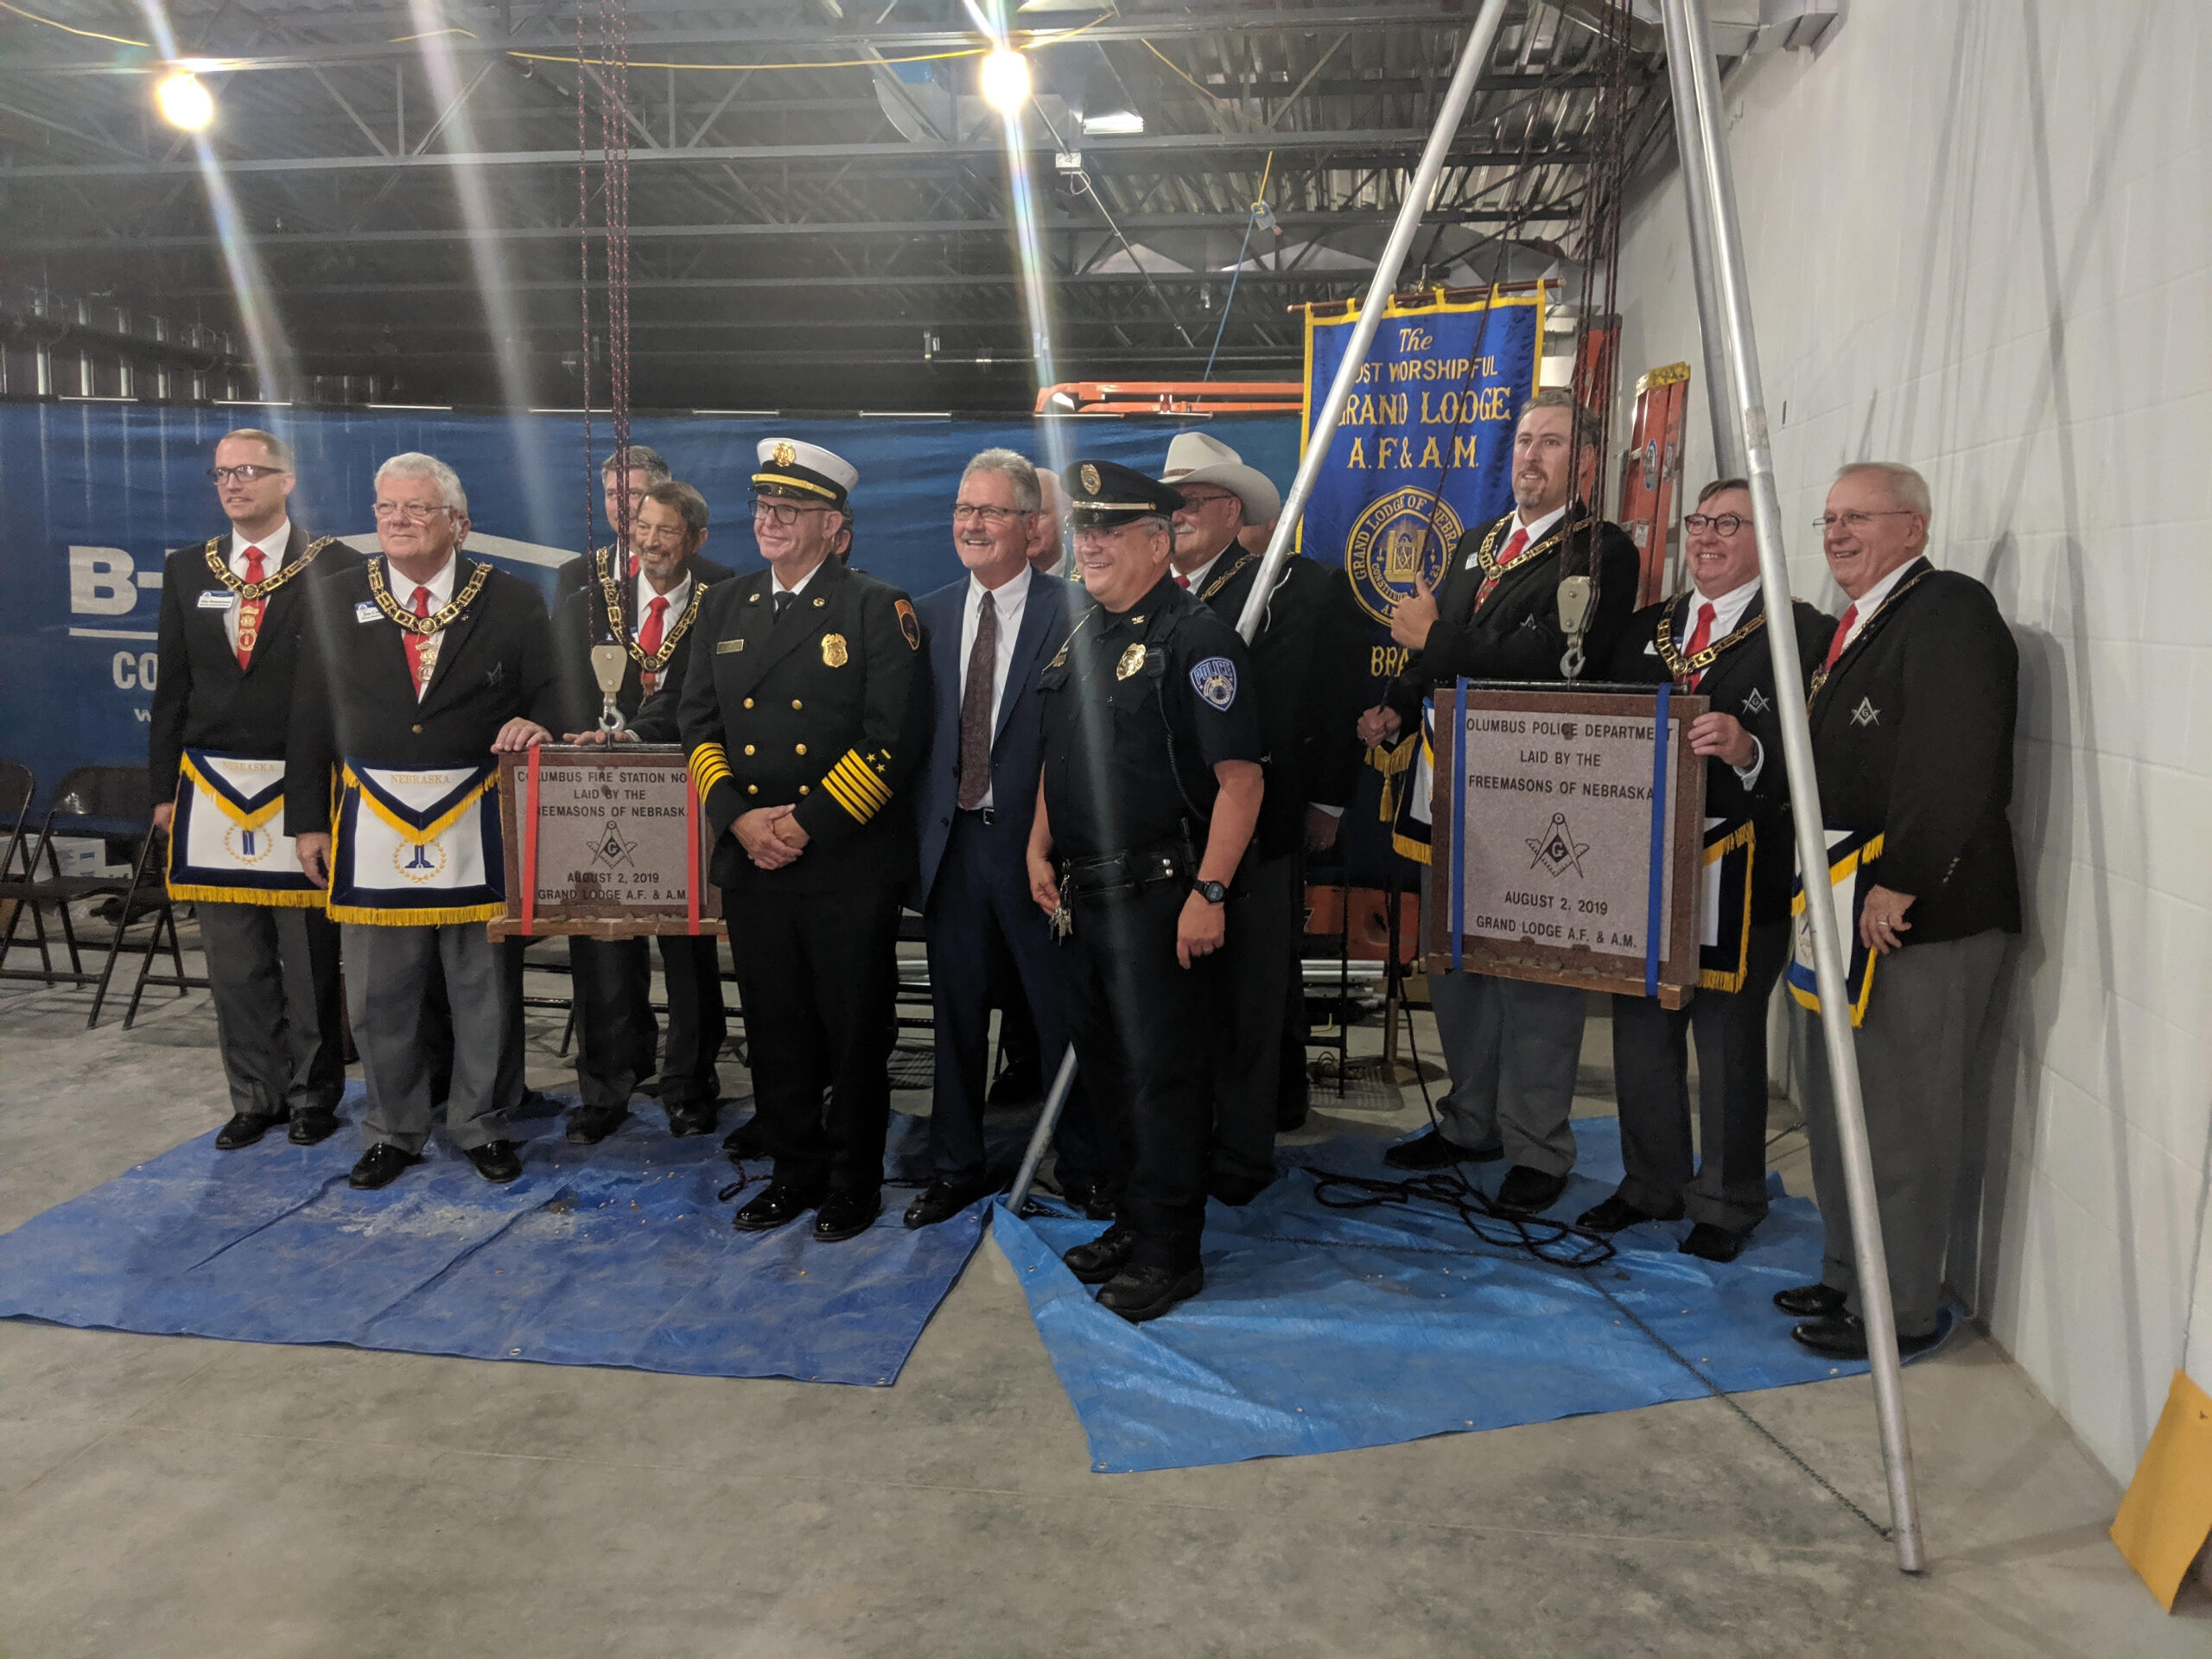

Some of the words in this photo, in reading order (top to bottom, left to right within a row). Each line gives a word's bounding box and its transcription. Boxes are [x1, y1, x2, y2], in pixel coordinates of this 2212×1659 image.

[1399, 327, 1433, 353] The
[1355, 362, 1383, 384] ST
[1389, 355, 1497, 382] WORSHIPFUL
[1420, 387, 1512, 424] LODGE
[1352, 531, 1371, 581] GRAND
[1366, 495, 1406, 531] LODGE
[1407, 494, 1427, 511] OF
[1427, 506, 1458, 559] NEBRA
[1371, 563, 1408, 601] CONSTITU
[1193, 660, 1234, 685] POLICE
[1466, 718, 1526, 734] OLUMBUS
[1532, 721, 1578, 737] POLICE
[1585, 723, 1674, 742] DEPARTMET
[1520, 749, 1548, 764] LAID
[1555, 752, 1571, 765] BY
[1576, 753, 1601, 767] THE
[390, 773, 450, 785] NEBRASKA
[518, 771, 582, 783] CUMBUS
[588, 771, 613, 783] FIRE
[619, 772, 665, 784] STATION
[1469, 774, 1553, 793] FREEMASONS
[1560, 781, 1577, 794] OF
[1582, 783, 1654, 800] NEBRASKA
[574, 788, 600, 799] LAID
[605, 788, 620, 799] BY
[624, 789, 646, 800] THE
[537, 805, 605, 817] EEMASONS
[611, 806, 626, 817] OF
[632, 806, 686, 817] NEBRASK
[567, 872, 612, 883] AUGUST
[618, 873, 628, 885] 2,
[633, 873, 659, 883] 2019
[537, 889, 577, 900] GRAND
[582, 889, 621, 900] LODGE
[626, 889, 647, 900] A.F.
[652, 889, 660, 900] &
[1504, 891, 1554, 907] AUGUST
[1560, 897, 1572, 912] 2,
[1579, 899, 1608, 916] 2019
[1477, 915, 1516, 932] GRAND
[1522, 921, 1562, 938] LODGE
[1567, 927, 1590, 942] A.F.
[1597, 931, 1605, 944] &
[1611, 932, 1637, 949] A.M.
